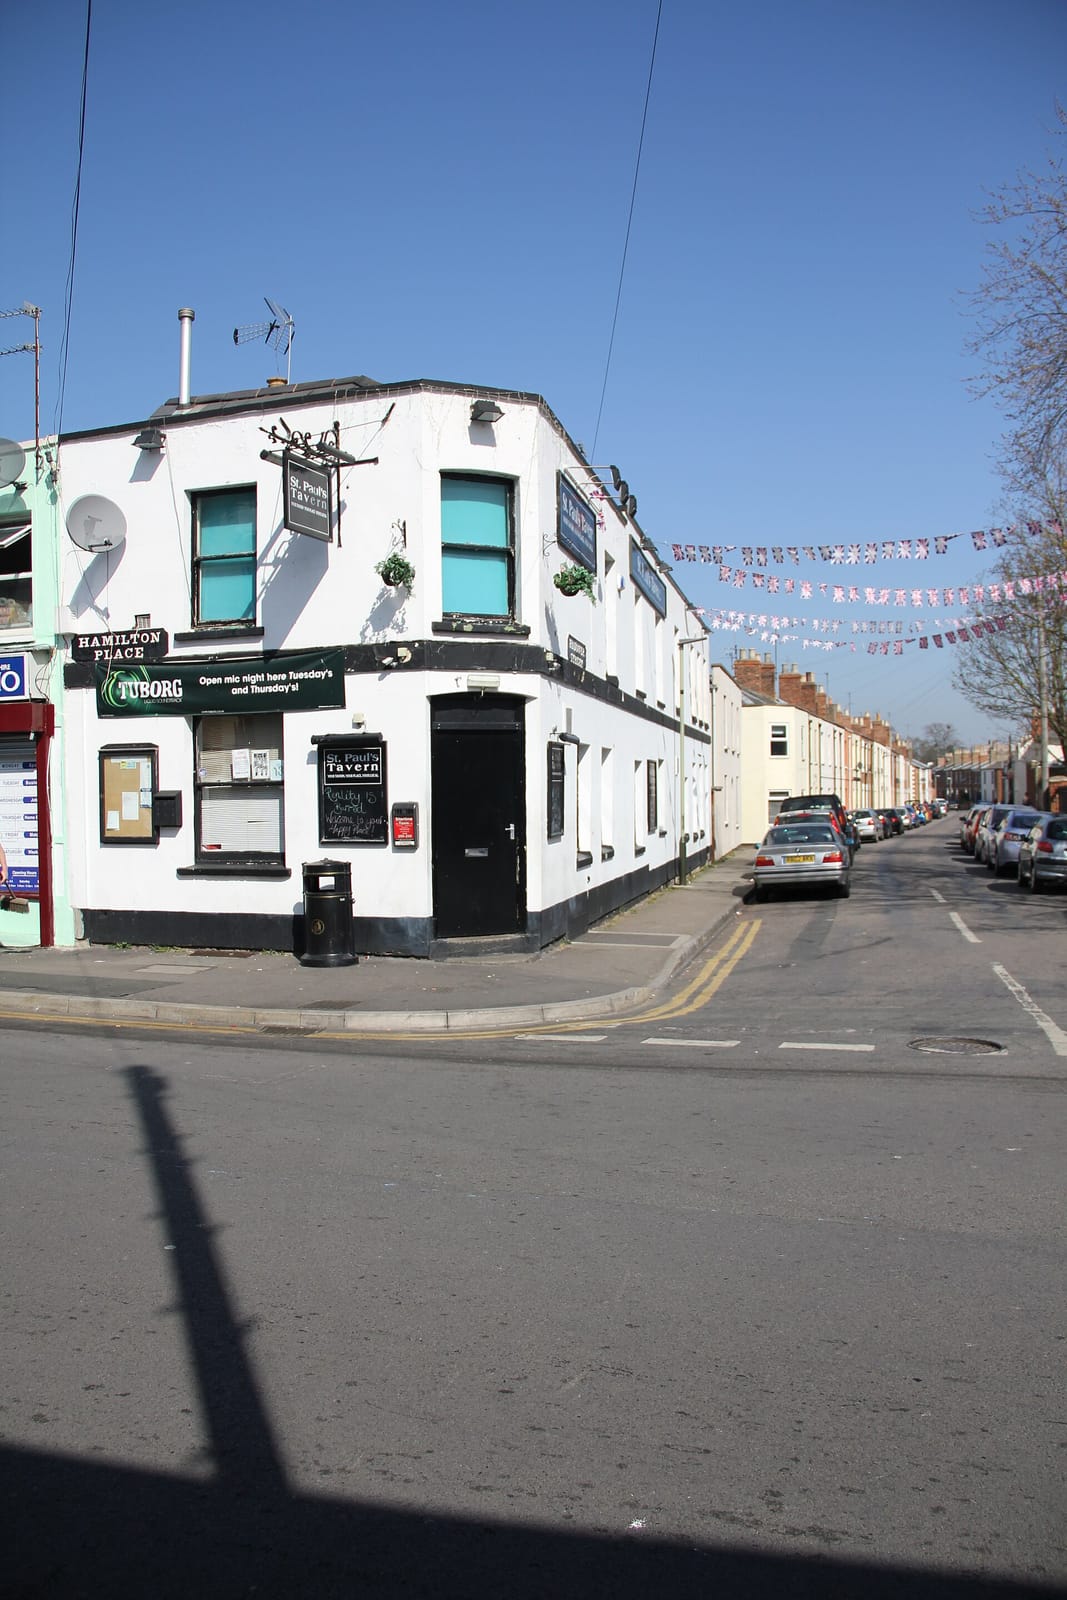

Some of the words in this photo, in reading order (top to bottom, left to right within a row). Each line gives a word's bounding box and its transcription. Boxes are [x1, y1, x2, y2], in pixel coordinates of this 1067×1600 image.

[303, 480, 327, 499] Paul's
[290, 487, 327, 510] Tavern
[78, 632, 161, 648] HAMILTON
[94, 647, 144, 661] PLACE
[199, 676, 222, 686] Open
[224, 675, 241, 684] mic
[242, 673, 265, 684] night
[267, 672, 287, 681] here
[289, 668, 333, 680] Tuesday's
[118, 679, 183, 700] TUBORG
[231, 685, 248, 695] and
[251, 682, 299, 694] Thursday's!
[326, 753, 341, 763] St.
[344, 752, 379, 762] Paul's
[326, 763, 379, 772] Tavern
